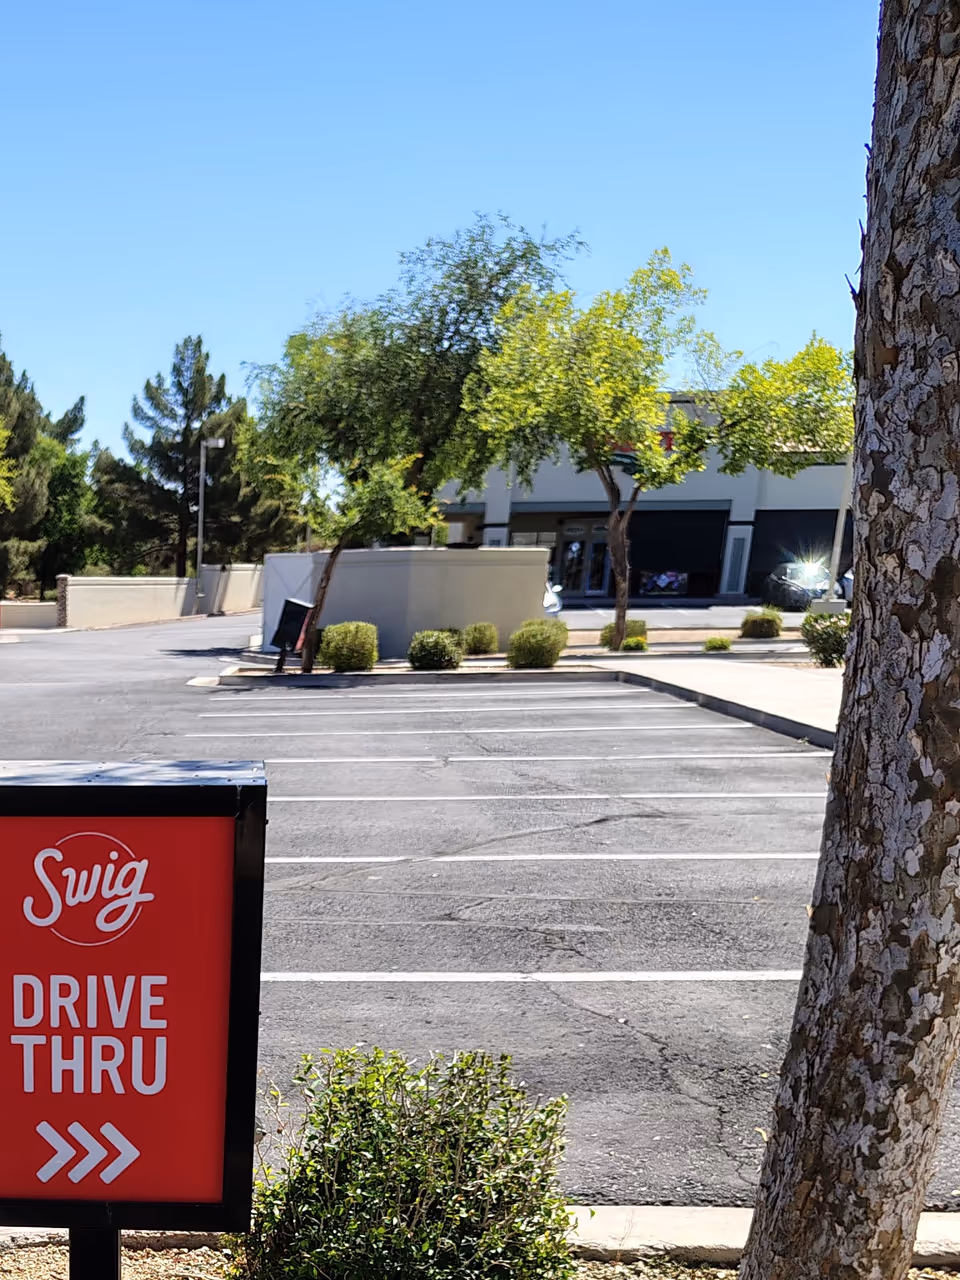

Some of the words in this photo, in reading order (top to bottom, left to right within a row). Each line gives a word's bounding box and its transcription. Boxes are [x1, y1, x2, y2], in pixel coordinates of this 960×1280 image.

[23, 847, 155, 933] Swig
[13, 974, 168, 1029] DRIVE
[10, 1034, 167, 1095] THRU
